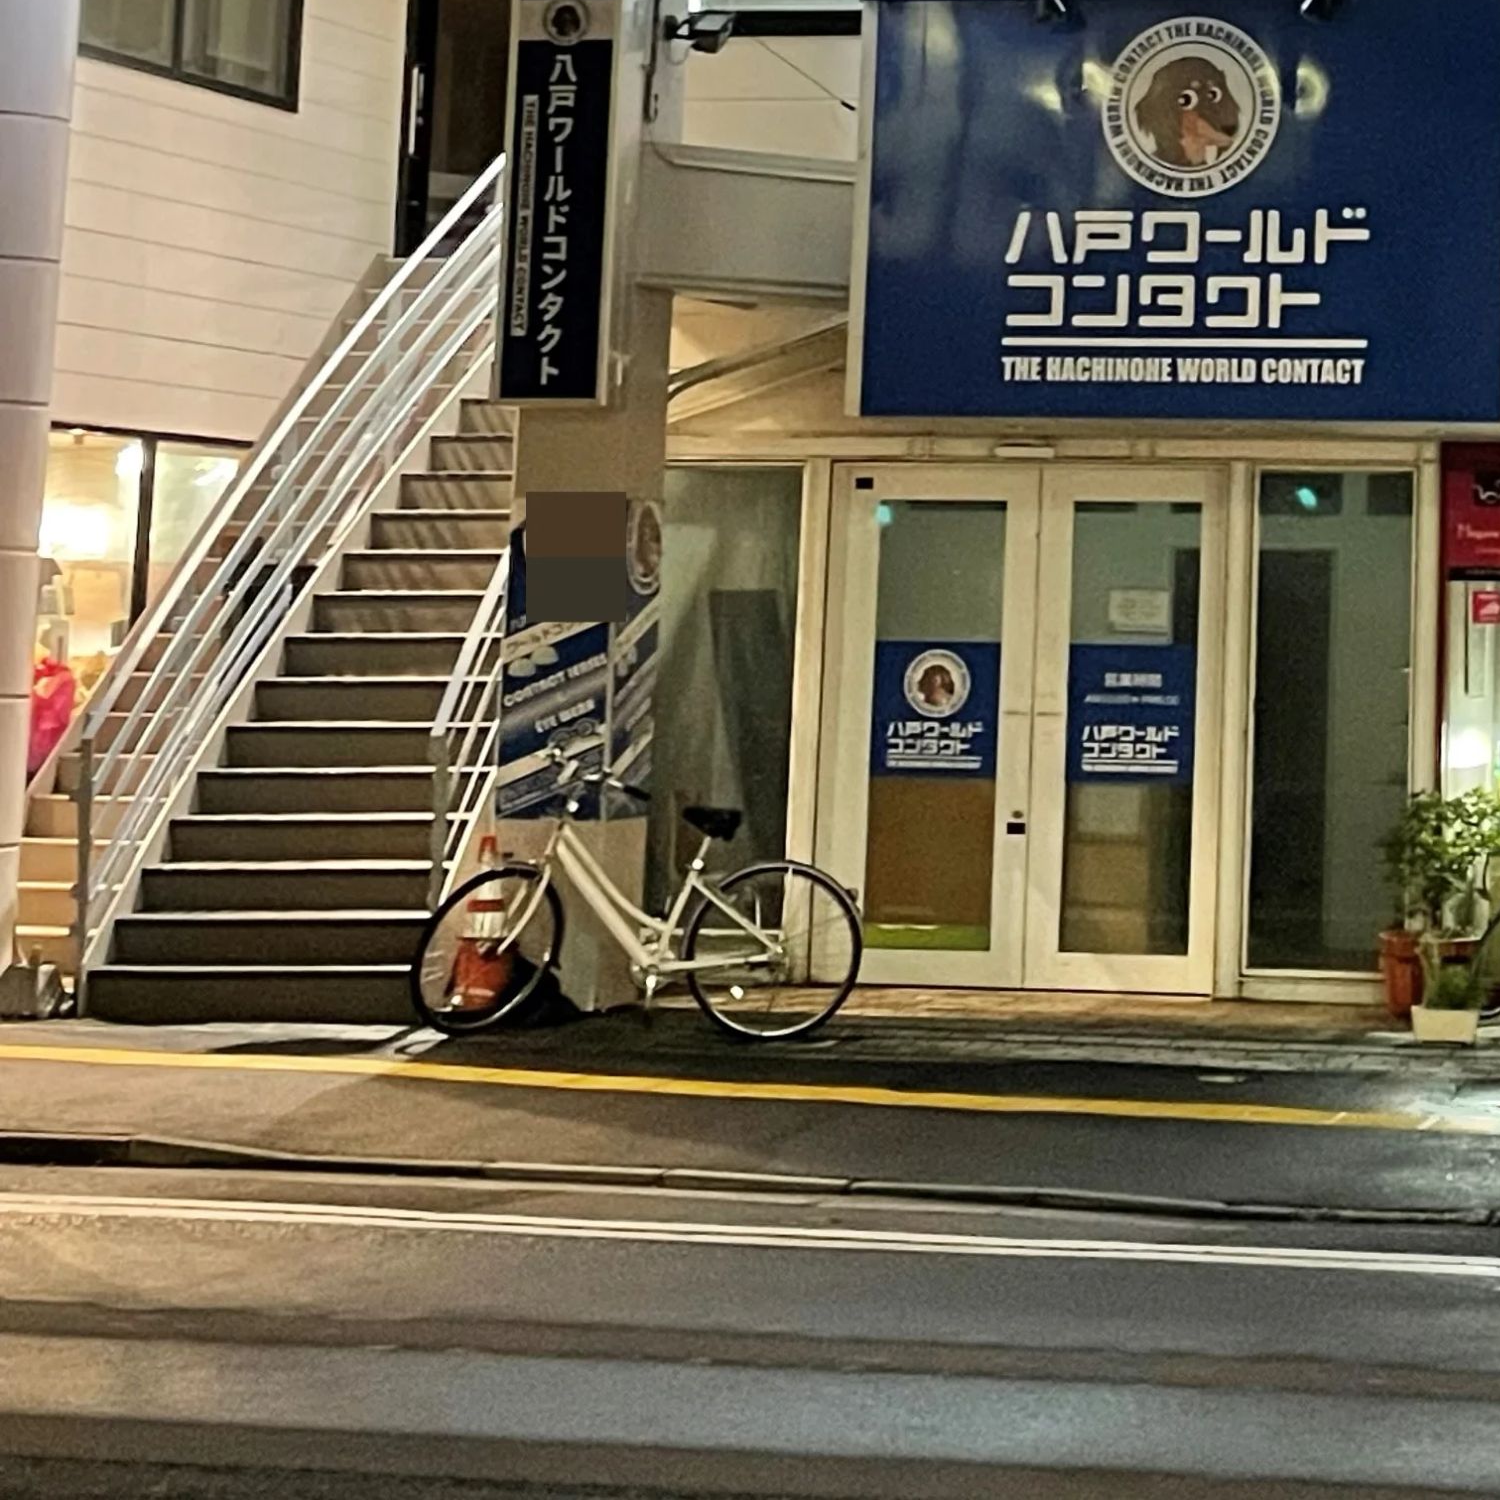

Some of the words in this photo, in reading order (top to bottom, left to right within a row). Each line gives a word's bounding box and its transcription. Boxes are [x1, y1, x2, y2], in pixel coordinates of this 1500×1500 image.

[1166, 21, 1192, 39] THE
[537, 54, 578, 386] 八戸ワールドコンタクト
[1004, 206, 1371, 265] 八戸ワールド
[1004, 272, 1321, 329] コンタクト
[1001, 356, 1041, 381] THE
[1046, 357, 1172, 382] HACHINOHE
[1177, 358, 1256, 382] WORLD
[1262, 359, 1365, 384] CONTACT
[886, 738, 971, 756] コンタクト
[1081, 742, 1168, 759] コンタクト
